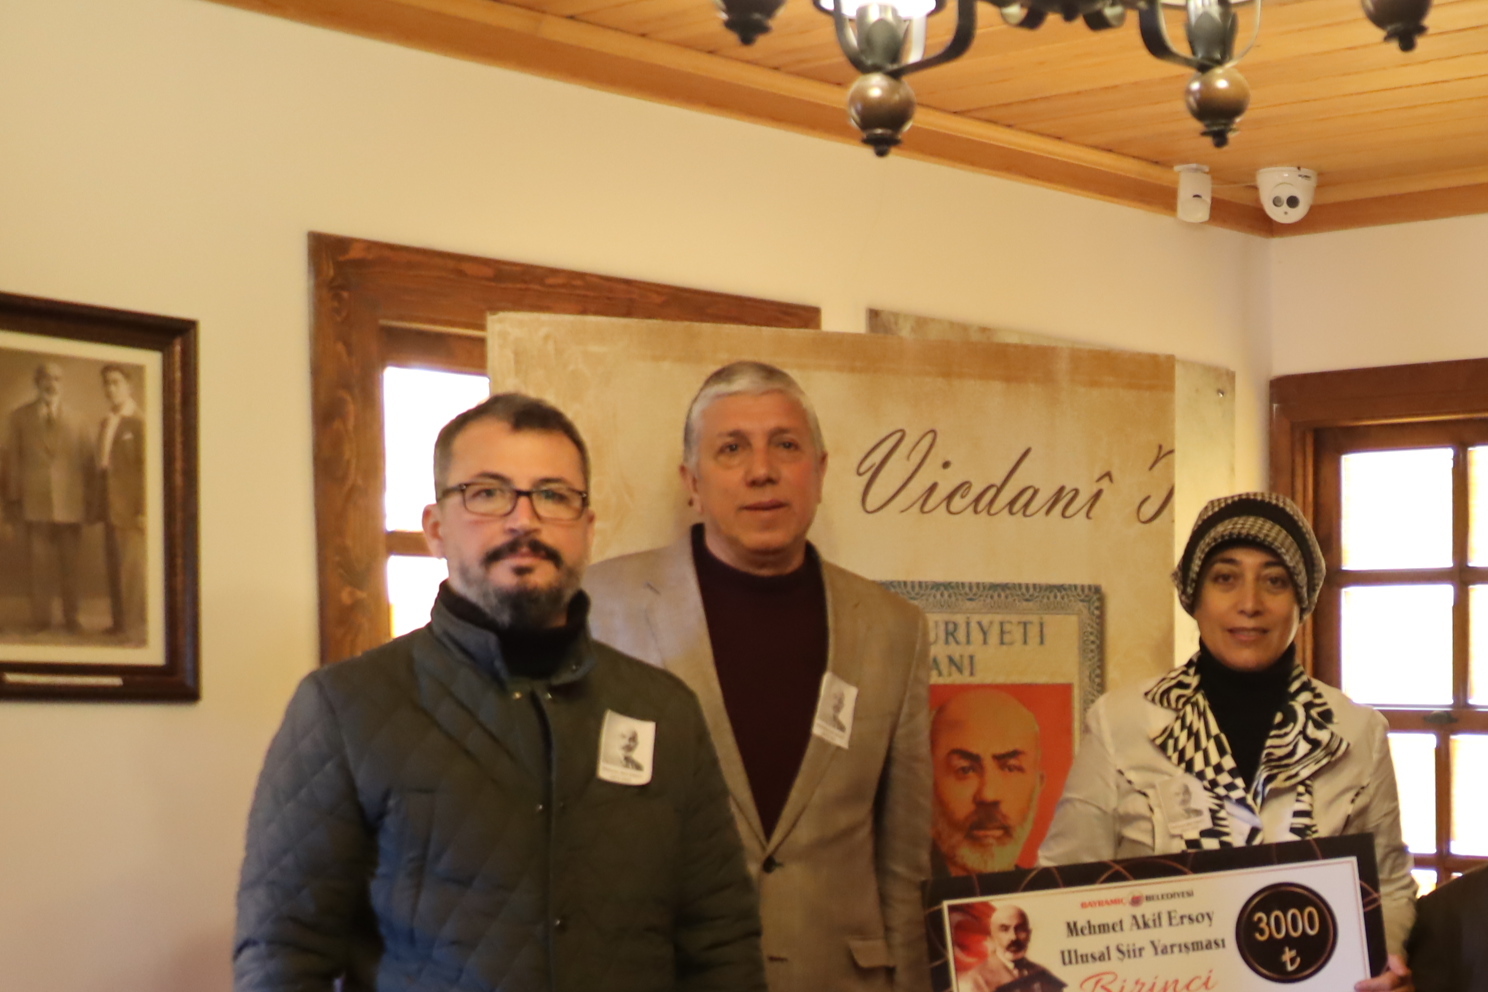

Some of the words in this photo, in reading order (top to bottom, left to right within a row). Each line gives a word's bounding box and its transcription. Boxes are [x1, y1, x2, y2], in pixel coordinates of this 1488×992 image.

[856, 428, 1114, 520] Vicdanî
[1065, 917, 1124, 938] Mehmet
[1130, 911, 1165, 932] Akif
[1166, 908, 1215, 928] Ersoy
[1252, 905, 1320, 942] 3000
[1060, 945, 1112, 967] Ulusal
[1115, 942, 1146, 962] Şiir
[1149, 937, 1227, 957] Yarışması
